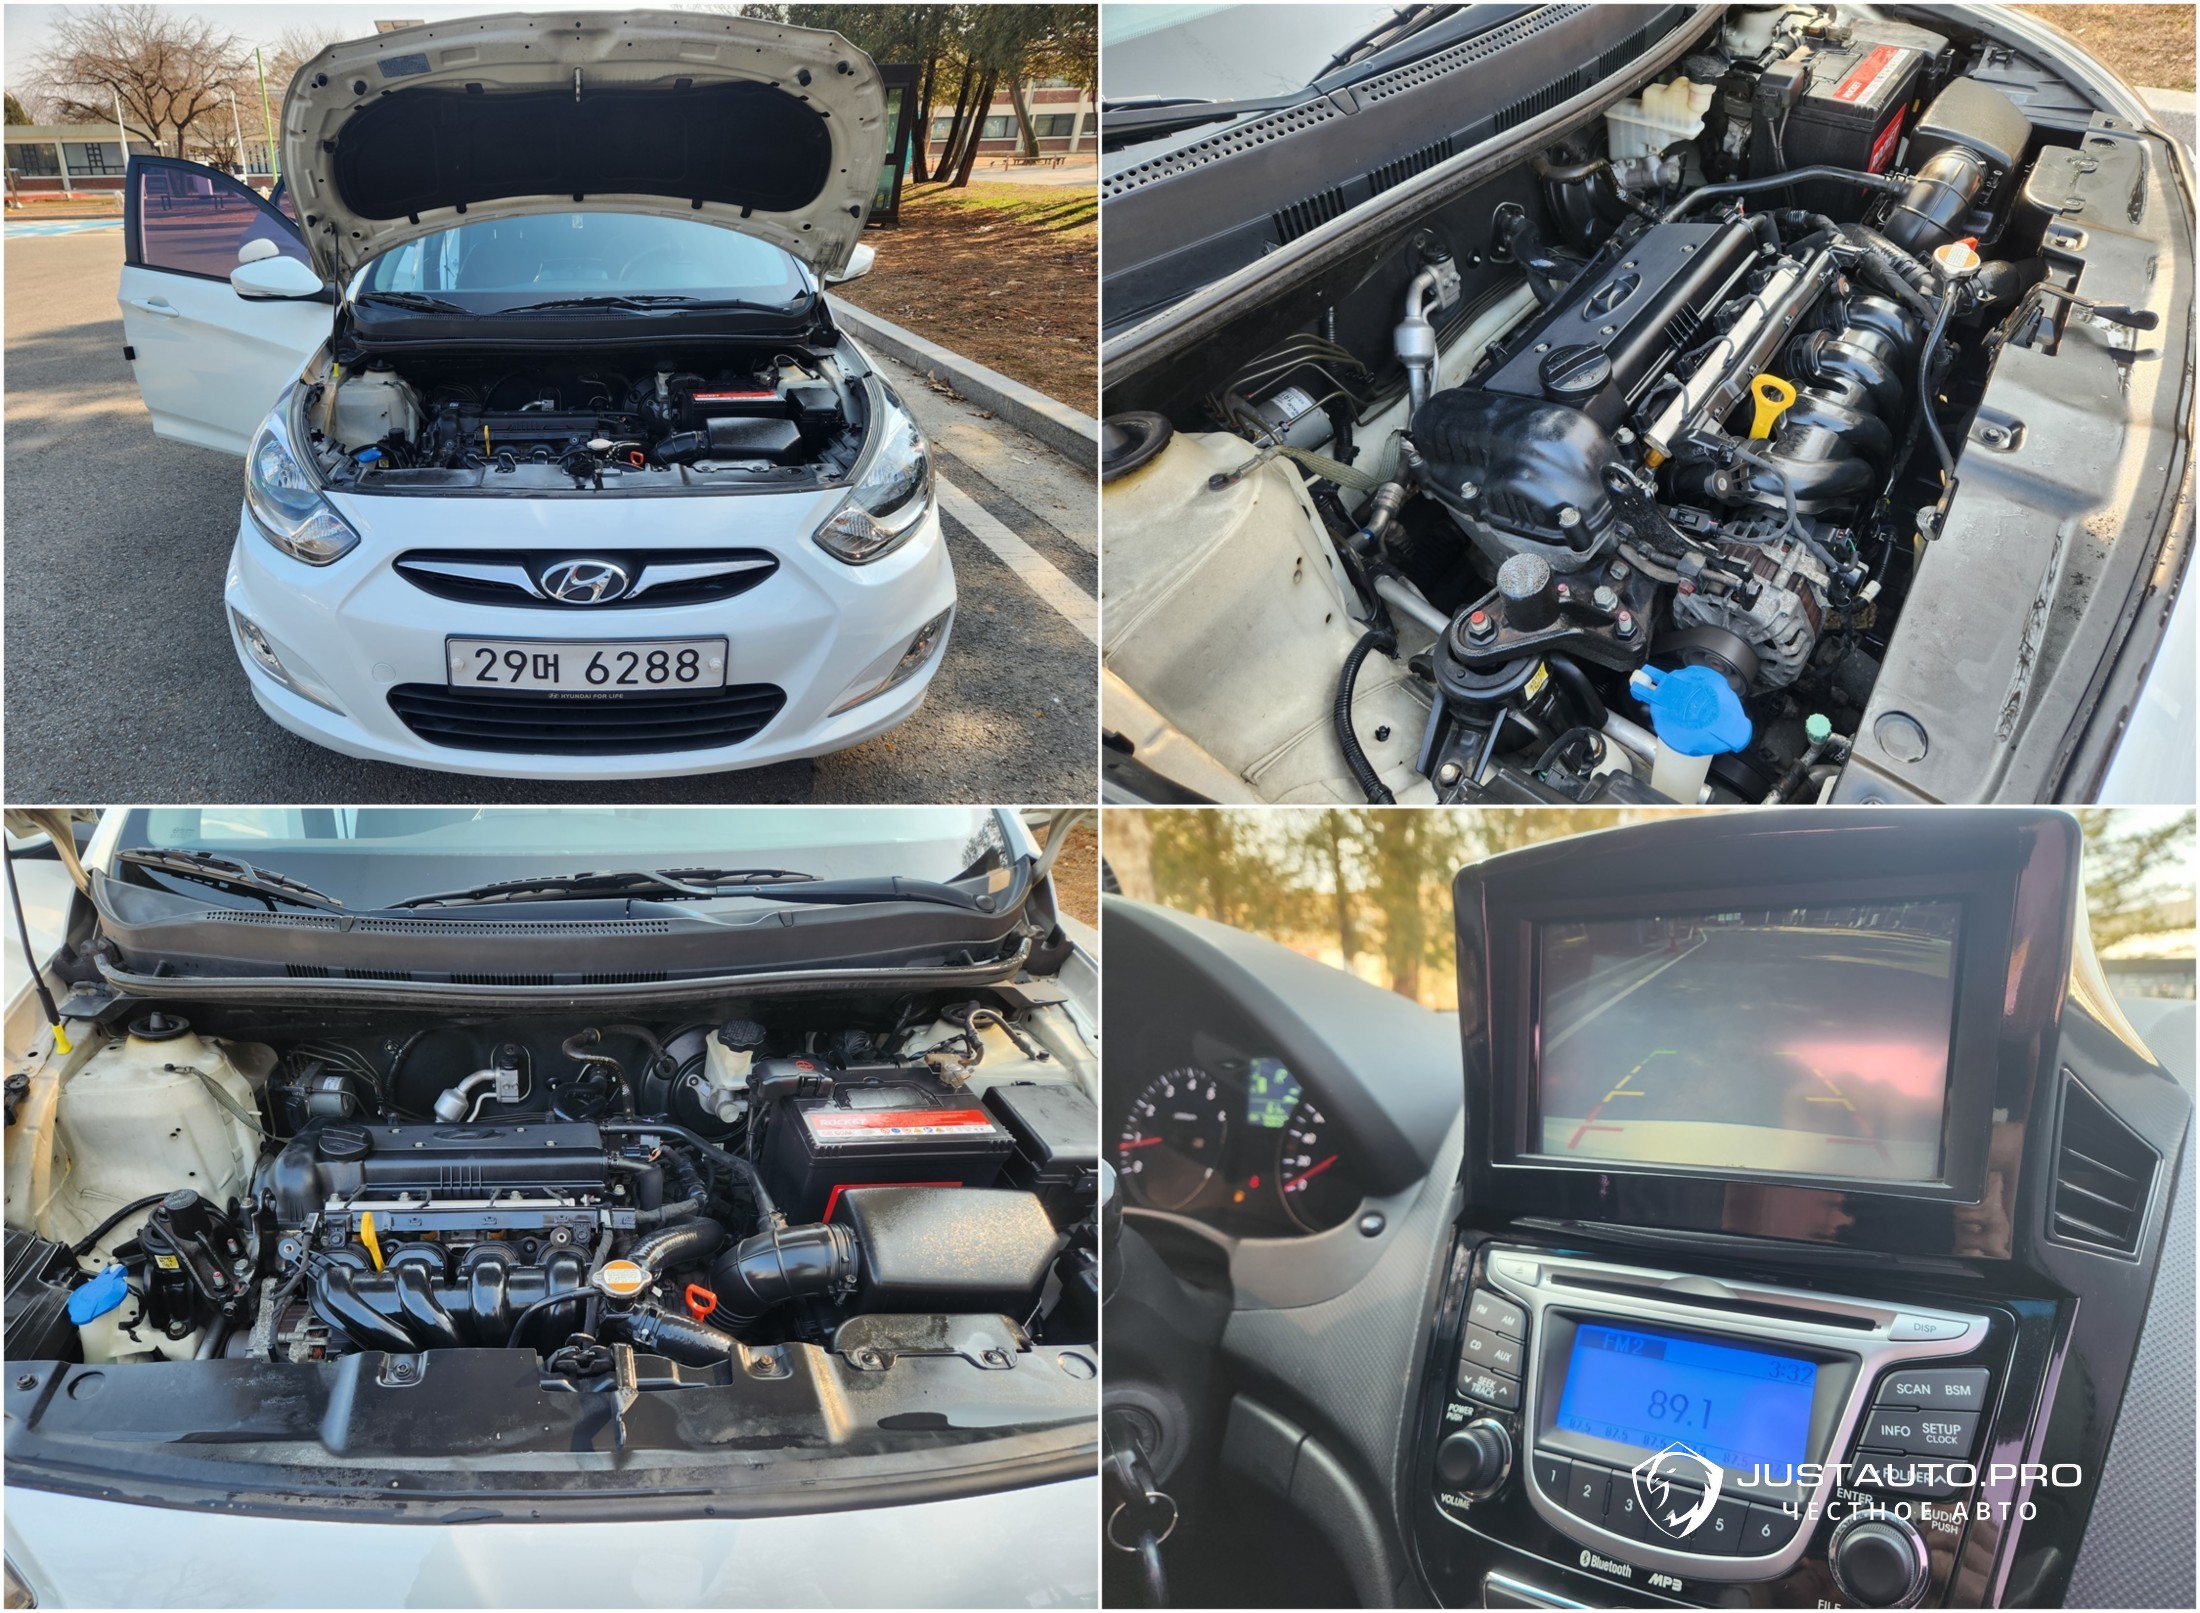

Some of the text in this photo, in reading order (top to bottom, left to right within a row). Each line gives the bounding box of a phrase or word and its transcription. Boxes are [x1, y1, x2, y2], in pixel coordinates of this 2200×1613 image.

[475, 648, 700, 685] 29머 6288
[1475, 1304, 1488, 1315] FM
[1501, 1315, 1515, 1326] AM
[1913, 1322, 1937, 1333] DISP
[1469, 1339, 1482, 1350] CD
[1603, 1333, 1645, 1355] FM2
[1494, 1349, 1512, 1362] AUX
[1768, 1360, 1814, 1384] 3:32
[1476, 1376, 1497, 1389] SEEK
[1896, 1383, 1931, 1395] SCAN
[1471, 1382, 1497, 1399] TRACK
[1945, 1384, 1971, 1396] BSM
[1448, 1403, 1474, 1416] POWER
[1647, 1389, 1712, 1430] 89.1
[1446, 1412, 1463, 1421] PUSH
[1881, 1424, 1911, 1437] INFO
[1922, 1422, 1961, 1435] SETUP
[1568, 1417, 1591, 1433] 87.5
[1605, 1425, 1629, 1442] 87.5
[1643, 1433, 1667, 1449] 87.5
[1723, 1451, 1749, 1468] 87.5
[1926, 1435, 1958, 1444] CLOCK
[1551, 1470, 1556, 1482] 1
[1583, 1484, 1592, 1498] 2
[1837, 1488, 1873, 1505] ENTER
[1441, 1493, 1471, 1510] VOLUME
[1625, 1499, 1633, 1512] 3
[1715, 1518, 1724, 1532] 5
[1761, 1524, 1771, 1537] 6
[1931, 1521, 1959, 1534] PUSH
[1590, 1556, 1632, 1579] Bluetooth
[1648, 1573, 1683, 1592] MP3
